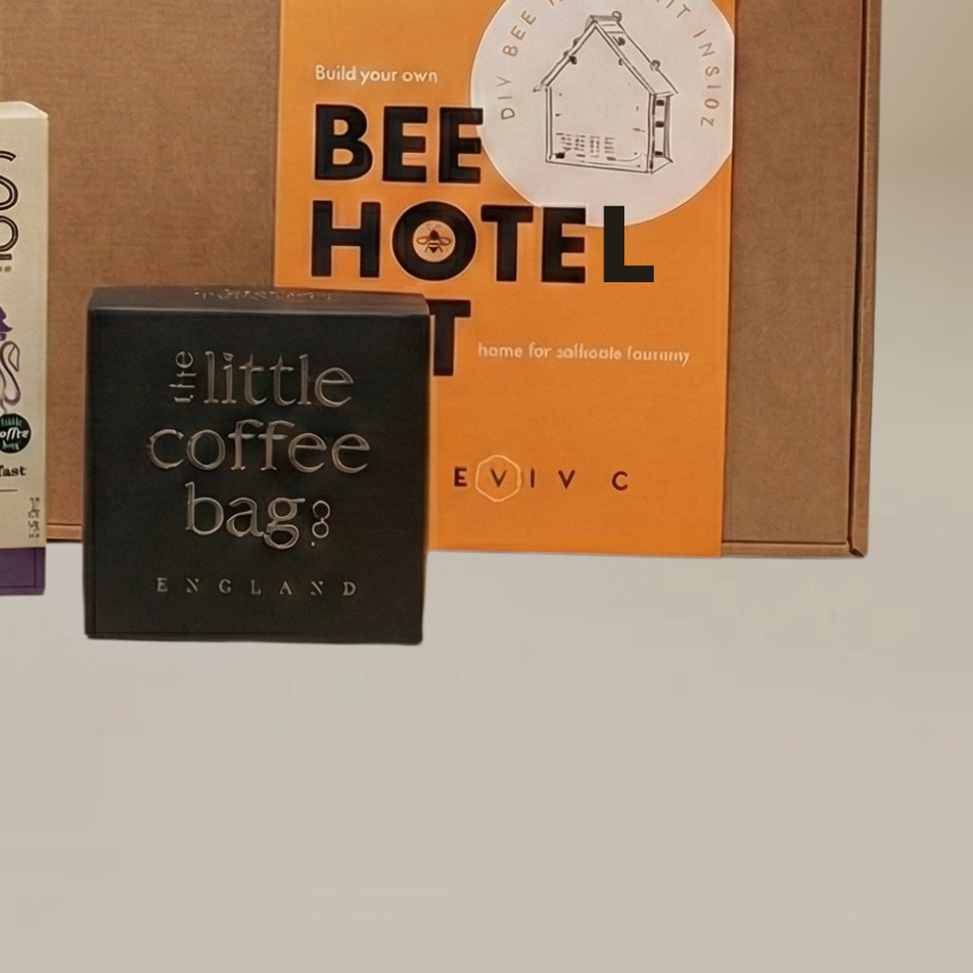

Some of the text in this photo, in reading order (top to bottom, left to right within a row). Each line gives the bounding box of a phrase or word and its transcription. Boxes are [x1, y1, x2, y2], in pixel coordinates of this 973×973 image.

[502, 10, 537, 58] BEE
[315, 64, 439, 85] Build your own
[496, 76, 516, 120] DIY
[313, 103, 484, 185] BEE
[310, 199, 655, 284] HOTEL
[478, 341, 523, 358] home
[528, 340, 552, 358] for
[203, 350, 355, 408] little
[145, 418, 371, 474] coffee
[156, 577, 358, 597] ENGLAND
